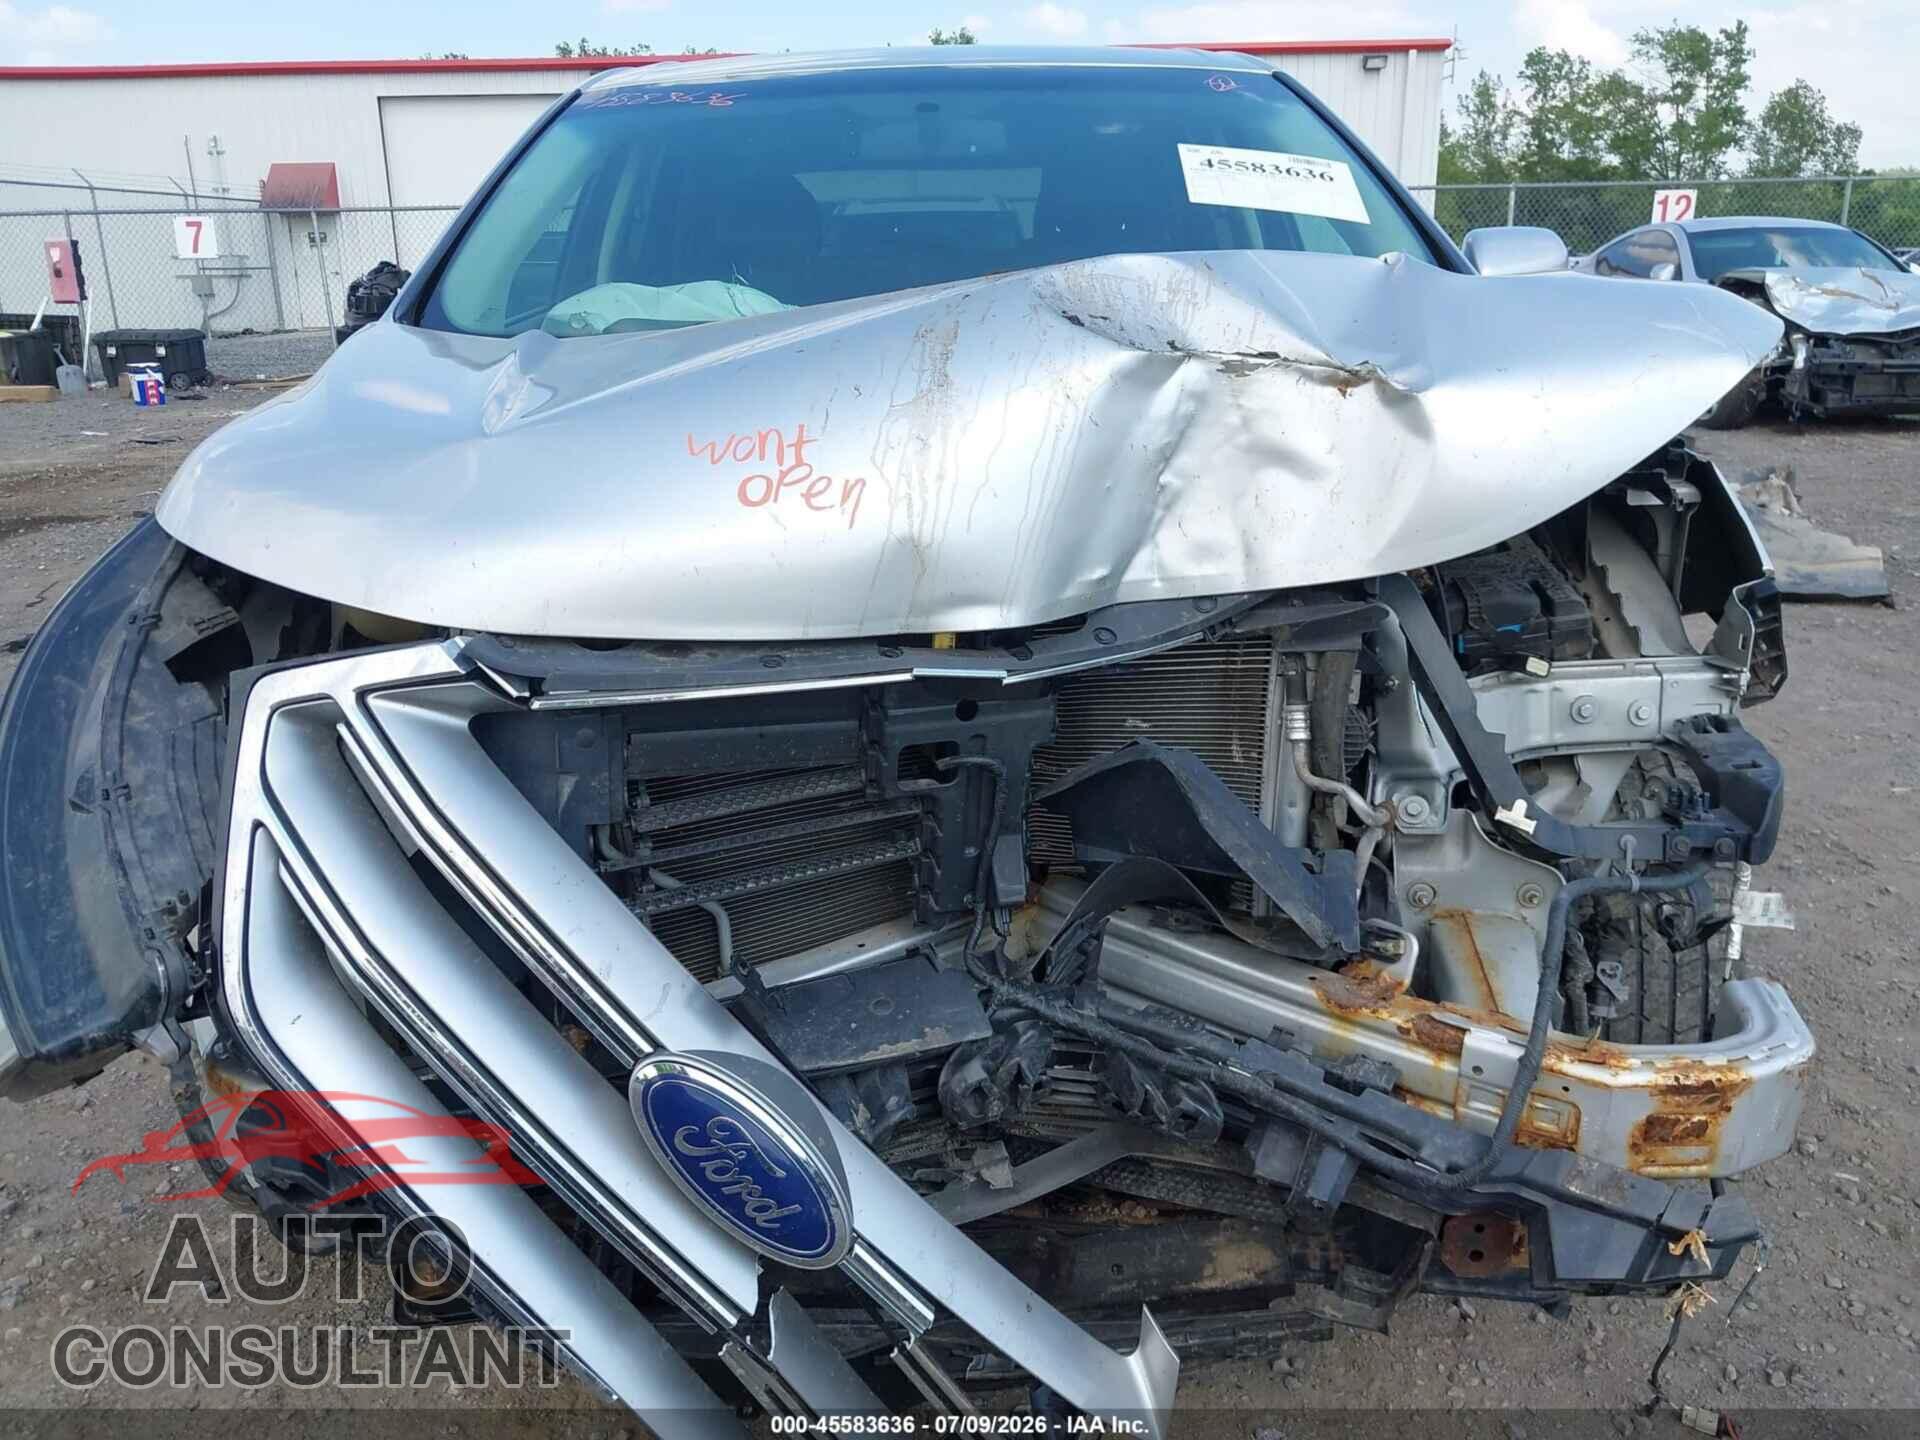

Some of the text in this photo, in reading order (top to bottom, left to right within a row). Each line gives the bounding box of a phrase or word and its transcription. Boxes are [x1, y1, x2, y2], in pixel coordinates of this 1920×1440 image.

[1199, 157, 1335, 182] 45583636
[1657, 194, 1692, 224] 12
[185, 221, 202, 253] 7
[673, 1116, 802, 1229] Ford
